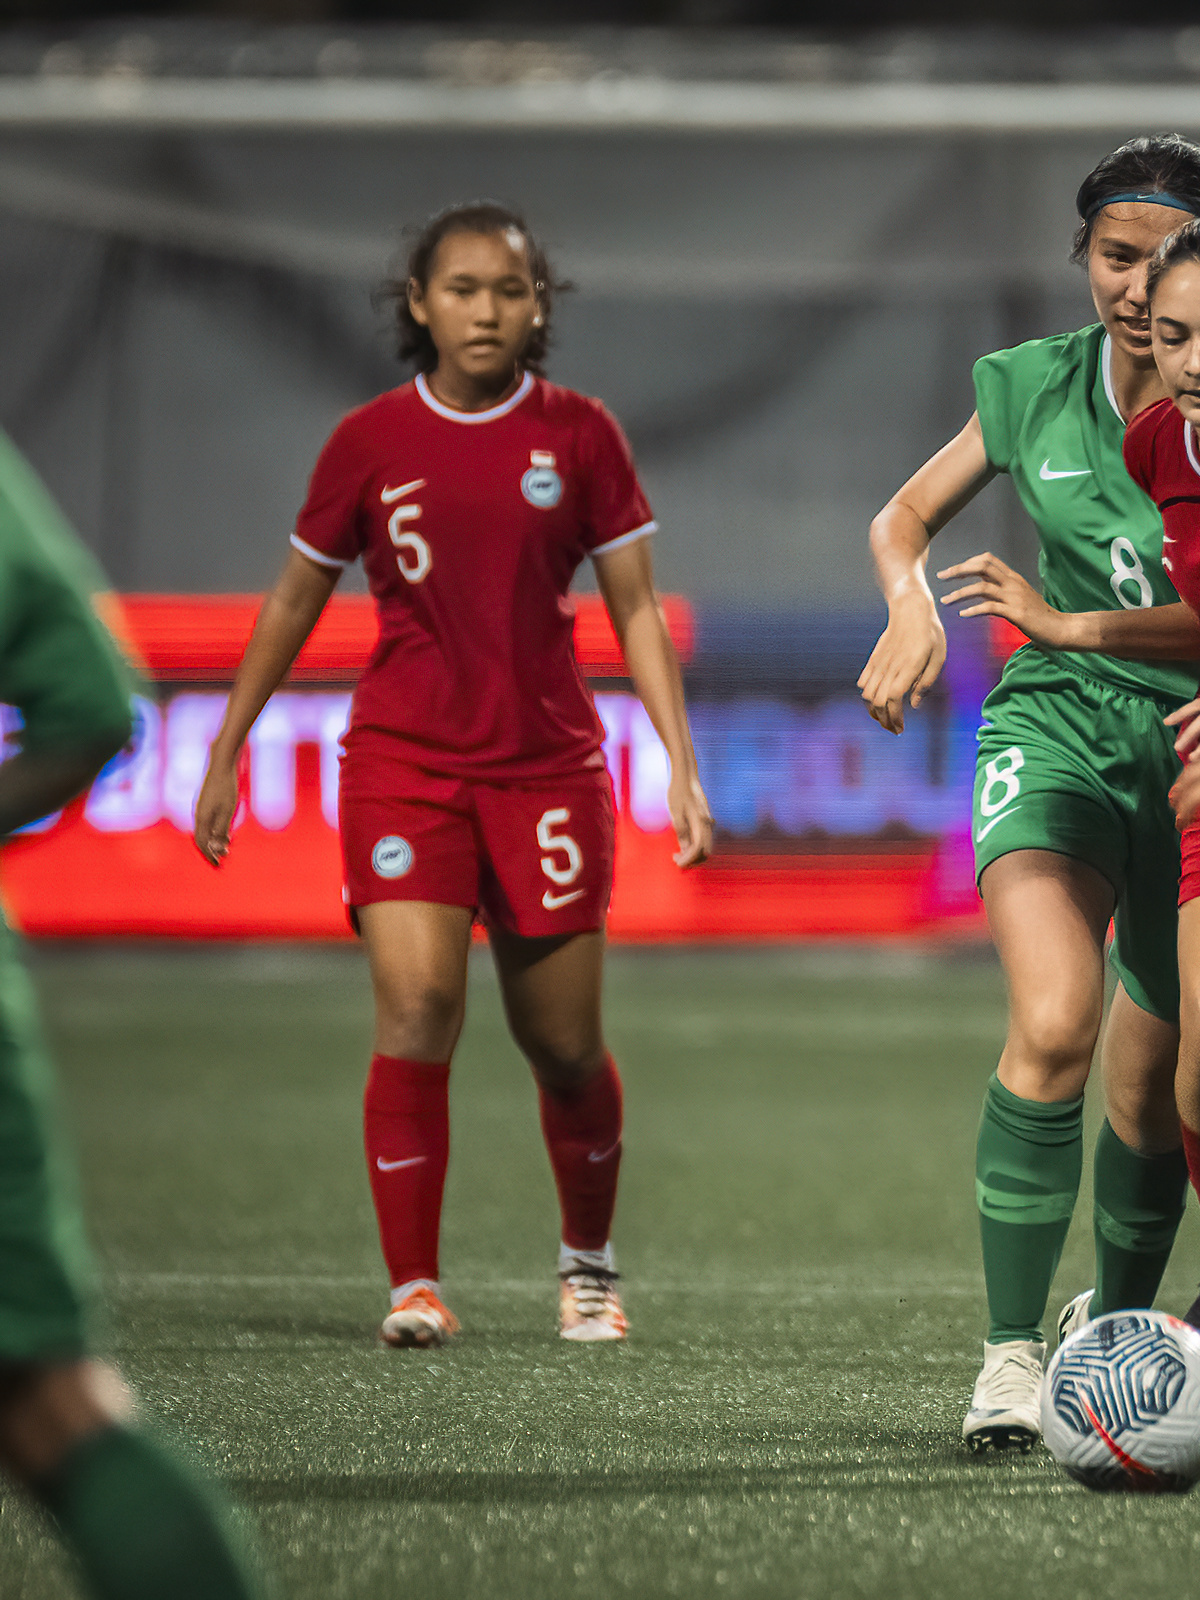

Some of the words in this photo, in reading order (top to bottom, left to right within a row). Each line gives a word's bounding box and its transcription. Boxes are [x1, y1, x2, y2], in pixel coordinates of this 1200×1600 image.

[388, 504, 431, 582] 5
[1110, 536, 1153, 610] 8
[981, 746, 1024, 817] 8
[537, 808, 582, 885] 5
